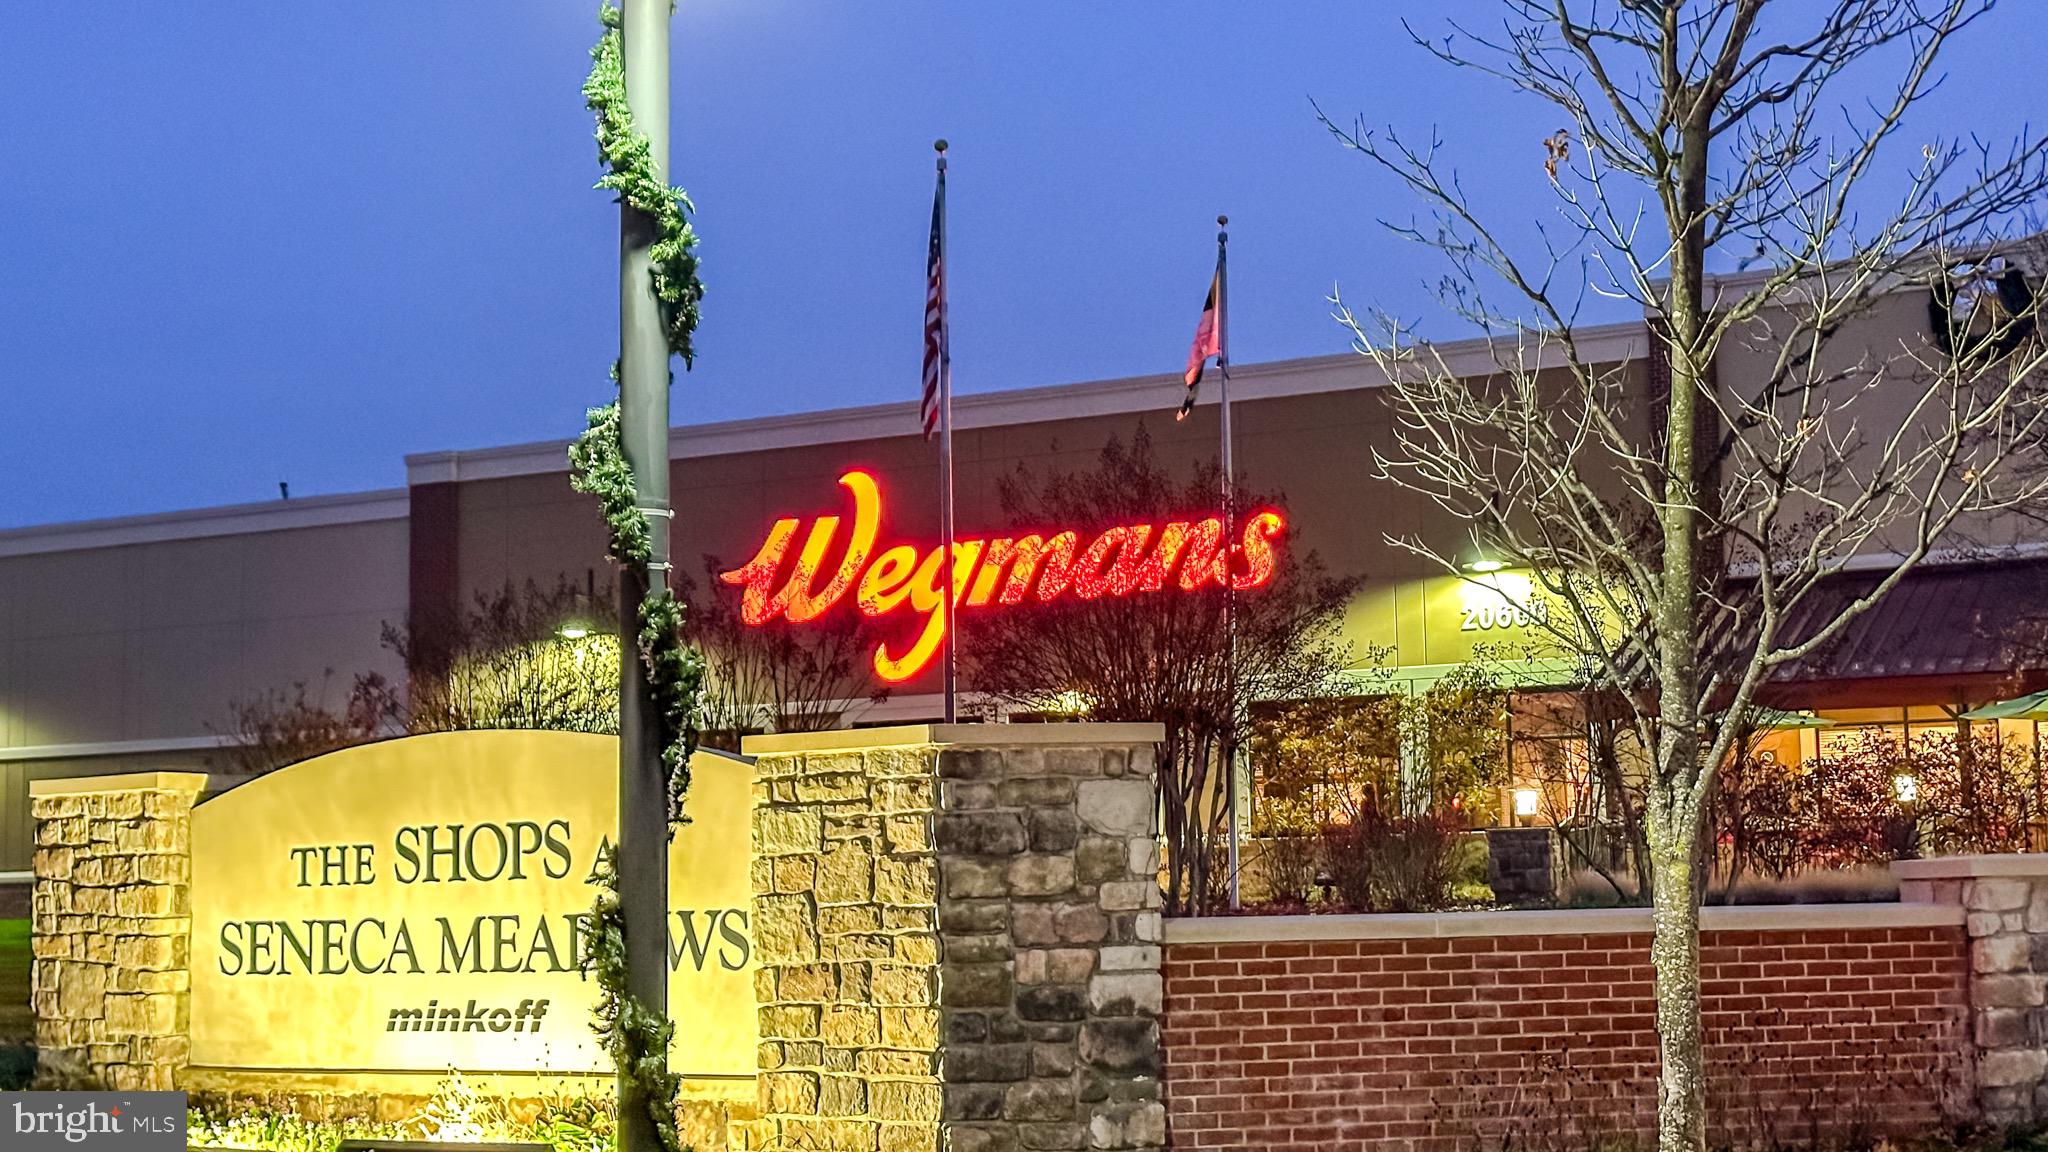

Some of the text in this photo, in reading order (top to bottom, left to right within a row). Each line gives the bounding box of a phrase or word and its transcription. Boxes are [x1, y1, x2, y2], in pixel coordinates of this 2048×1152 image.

[720, 471, 1283, 682] Wegmans
[291, 845, 376, 887] THE
[395, 820, 571, 884] SHOPS
[219, 918, 425, 976] SENECA
[386, 999, 550, 1033] minkoff
